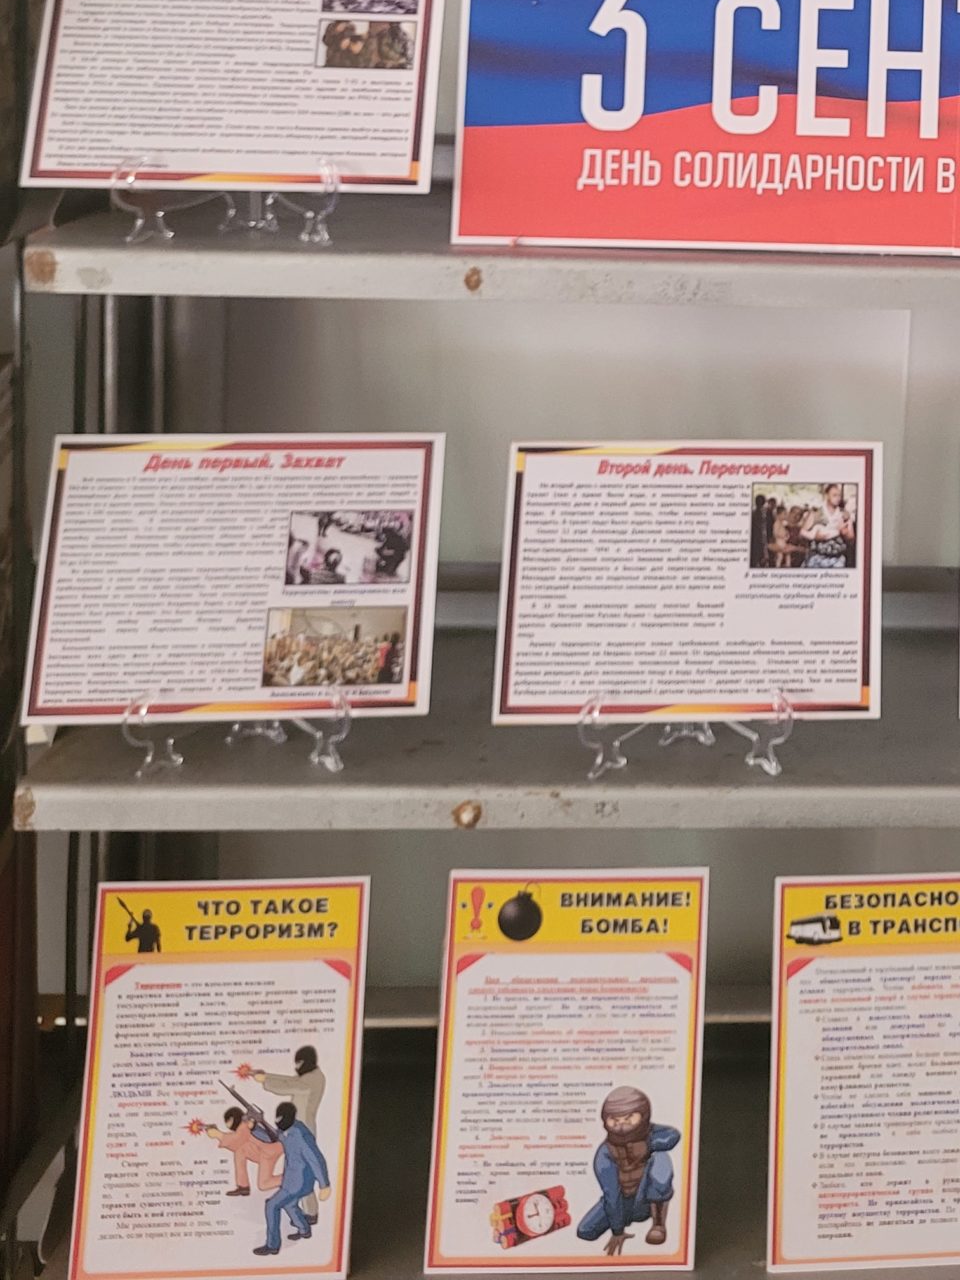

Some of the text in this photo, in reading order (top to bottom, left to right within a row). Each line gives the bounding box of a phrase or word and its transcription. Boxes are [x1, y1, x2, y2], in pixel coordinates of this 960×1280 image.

[577, 148, 661, 190] ДЕНЬ
[674, 151, 923, 195] СОЛИДАРНОСТИ
[936, 158, 955, 193] В
[144, 453, 192, 471] День
[282, 453, 343, 468] Захват
[597, 459, 788, 478] Второй день. Переговоры
[197, 898, 328, 916] ЧТО ТАКОЕ
[560, 892, 690, 907] ВНИМАНИЕ!
[184, 922, 338, 941] ТЕРРОРИЗМ?
[581, 918, 667, 934] БОМБА!
[848, 920, 860, 936] В
